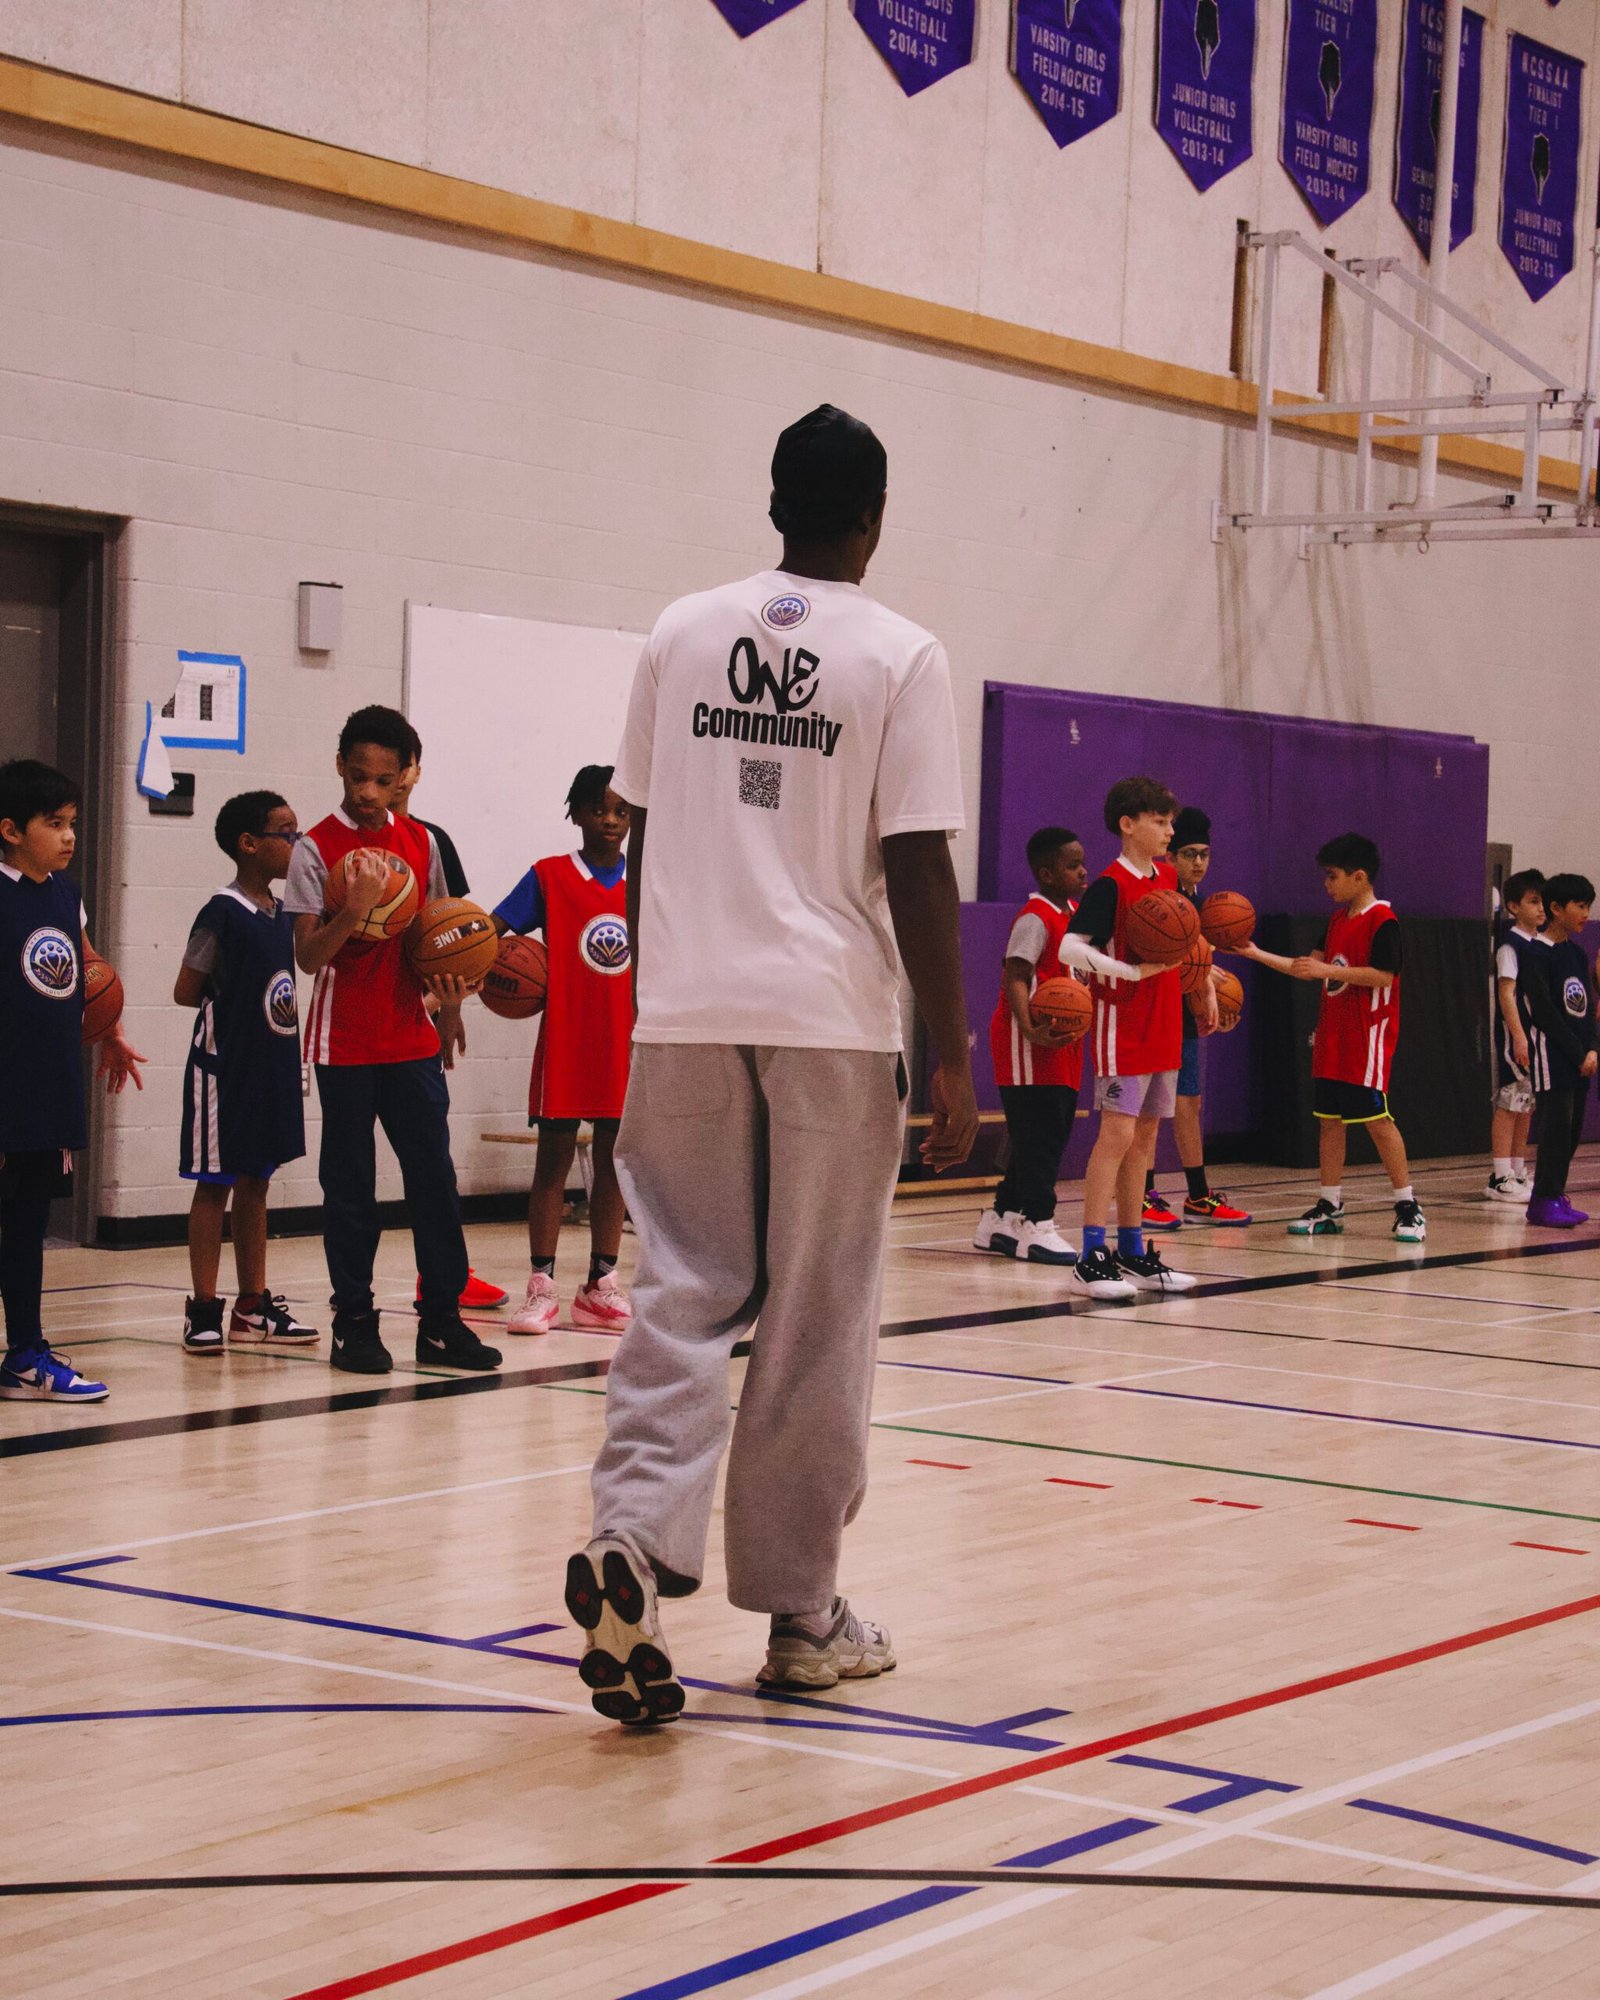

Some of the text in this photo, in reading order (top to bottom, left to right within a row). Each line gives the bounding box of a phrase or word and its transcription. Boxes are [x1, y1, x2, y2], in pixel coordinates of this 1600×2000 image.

[877, 0, 947, 43] VOLLEYBALL
[889, 28, 937, 67] 2014-15
[1031, 23, 1106, 72] VARSITY GIRLS
[1041, 84, 1085, 118] 2014-15
[1172, 83, 1236, 119] JUNIOR GIRLS
[1528, 82, 1563, 109] FINALIST
[1174, 108, 1232, 143] VOLLEYBALL
[1529, 104, 1547, 127] TIER
[1182, 137, 1224, 166] 2013-14
[1296, 120, 1358, 158] VARSITY GIRLS
[1295, 146, 1358, 183] FIELD HOCKEY
[1306, 175, 1345, 202] 2013-14
[1514, 208, 1562, 237] JUNIOR BOYS
[1515, 230, 1558, 258] VOLLEYBALL
[693, 702, 843, 756] Community
